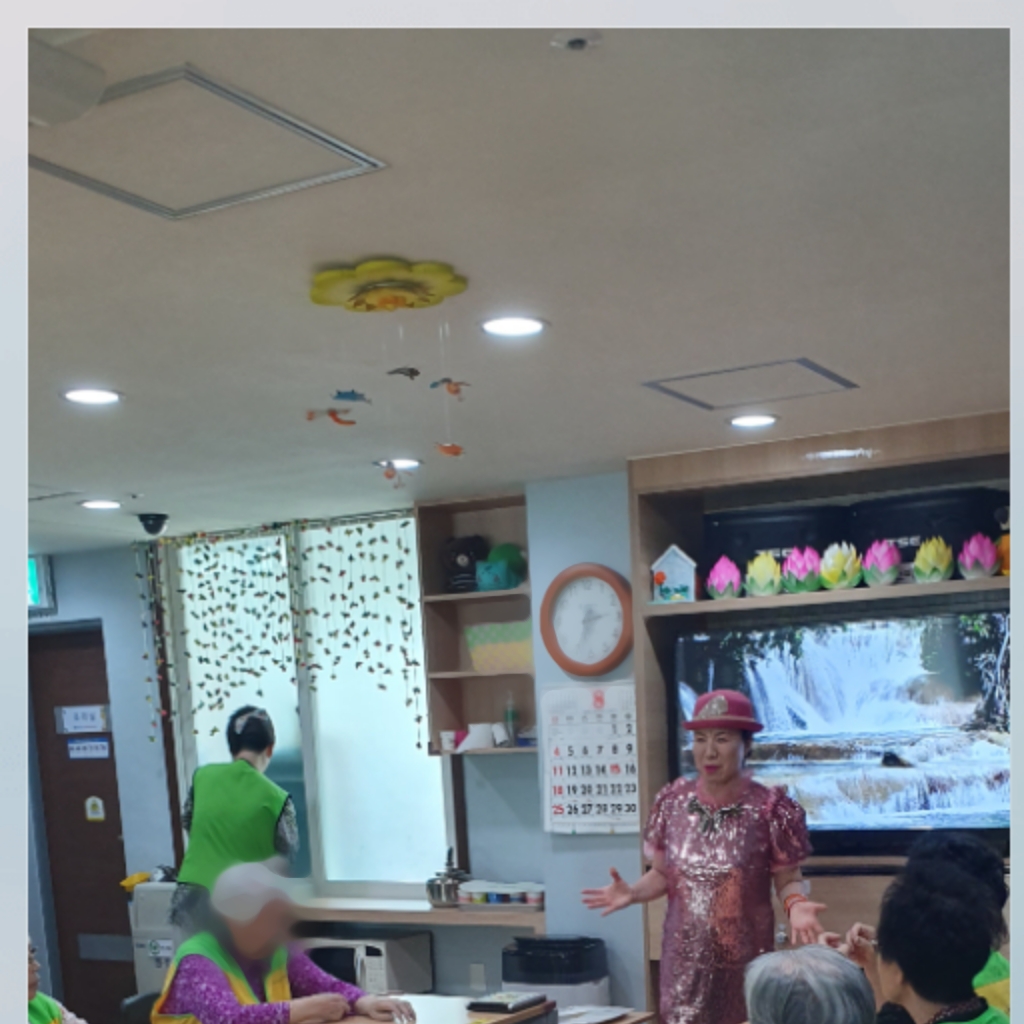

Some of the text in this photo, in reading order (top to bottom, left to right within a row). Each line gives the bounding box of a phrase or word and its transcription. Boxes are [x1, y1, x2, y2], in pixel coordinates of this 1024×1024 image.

[567, 746, 575, 757] 5
[582, 746, 589, 756] 6
[596, 745, 604, 756] 7
[611, 744, 619, 755] 8
[626, 743, 634, 755] 9
[552, 765, 564, 777] 11
[566, 765, 577, 777] 12
[581, 765, 592, 777] 13
[596, 764, 607, 776] 14
[625, 763, 636, 775] 16
[552, 783, 637, 796] 18 19 20 21 22 23
[552, 803, 637, 815] 25 26 27 28 29 30
